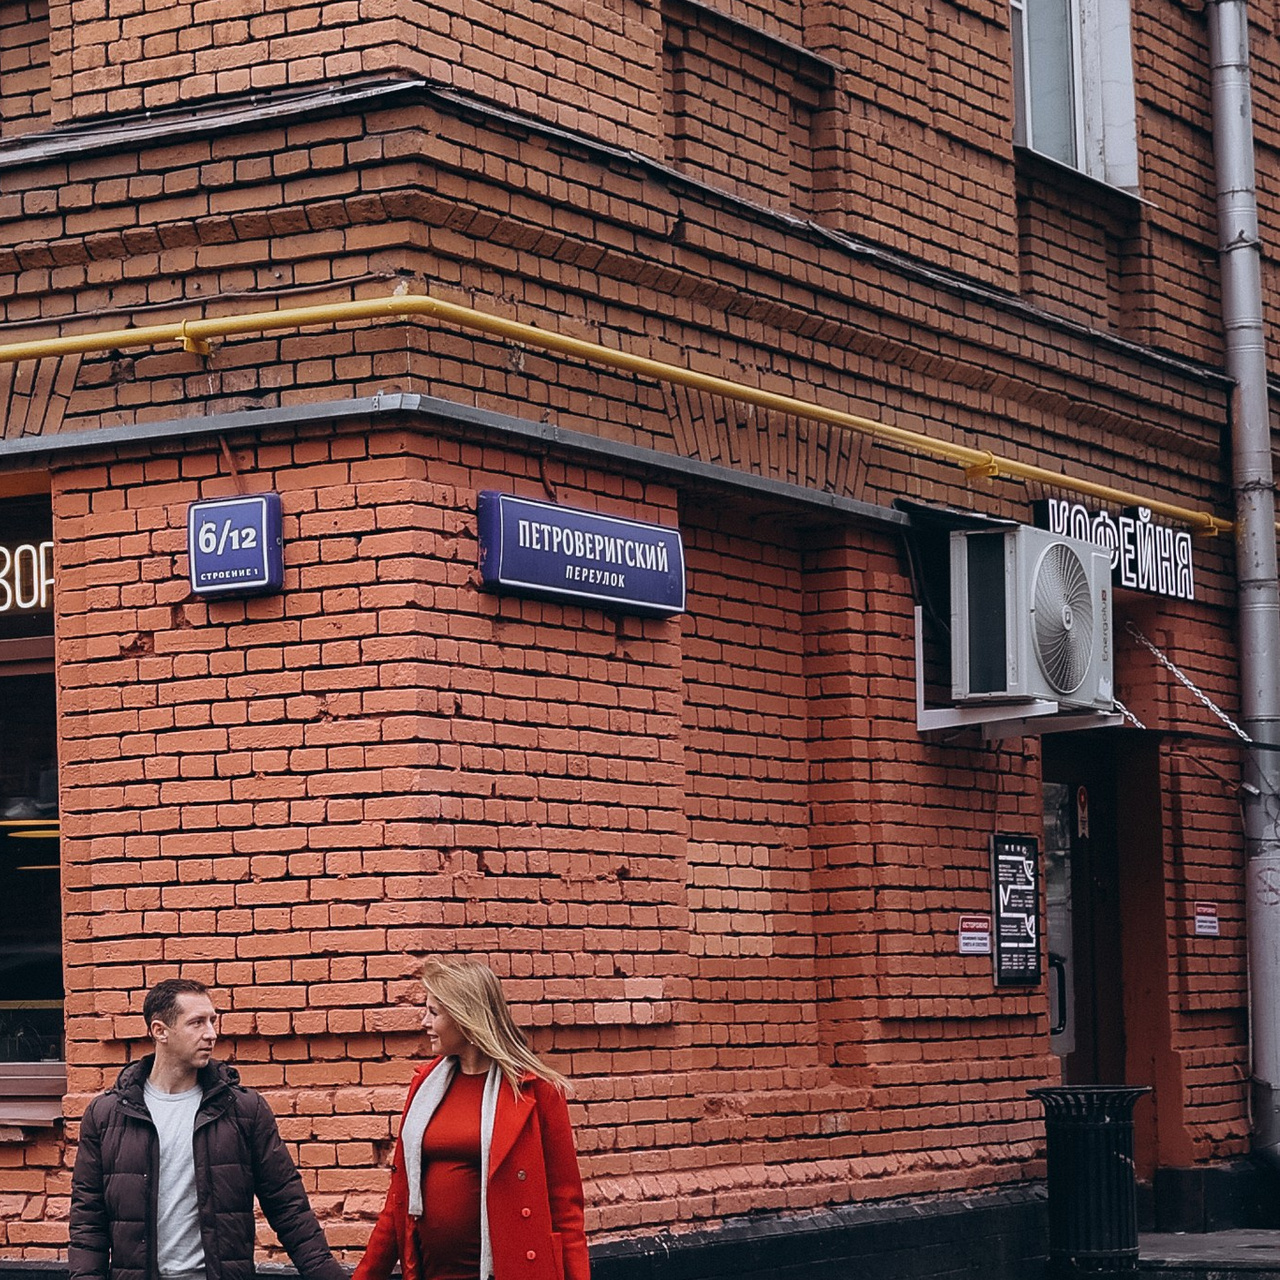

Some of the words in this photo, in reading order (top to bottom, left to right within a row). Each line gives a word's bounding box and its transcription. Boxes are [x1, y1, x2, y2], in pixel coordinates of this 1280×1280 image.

[198, 519, 257, 556] 6/12
[518, 519, 669, 573] ПЕТРОВЕРИГСКИЙ
[200, 569, 252, 581] СТРОЕНИЕ
[565, 565, 626, 588] ПЕРЕУЛОК
